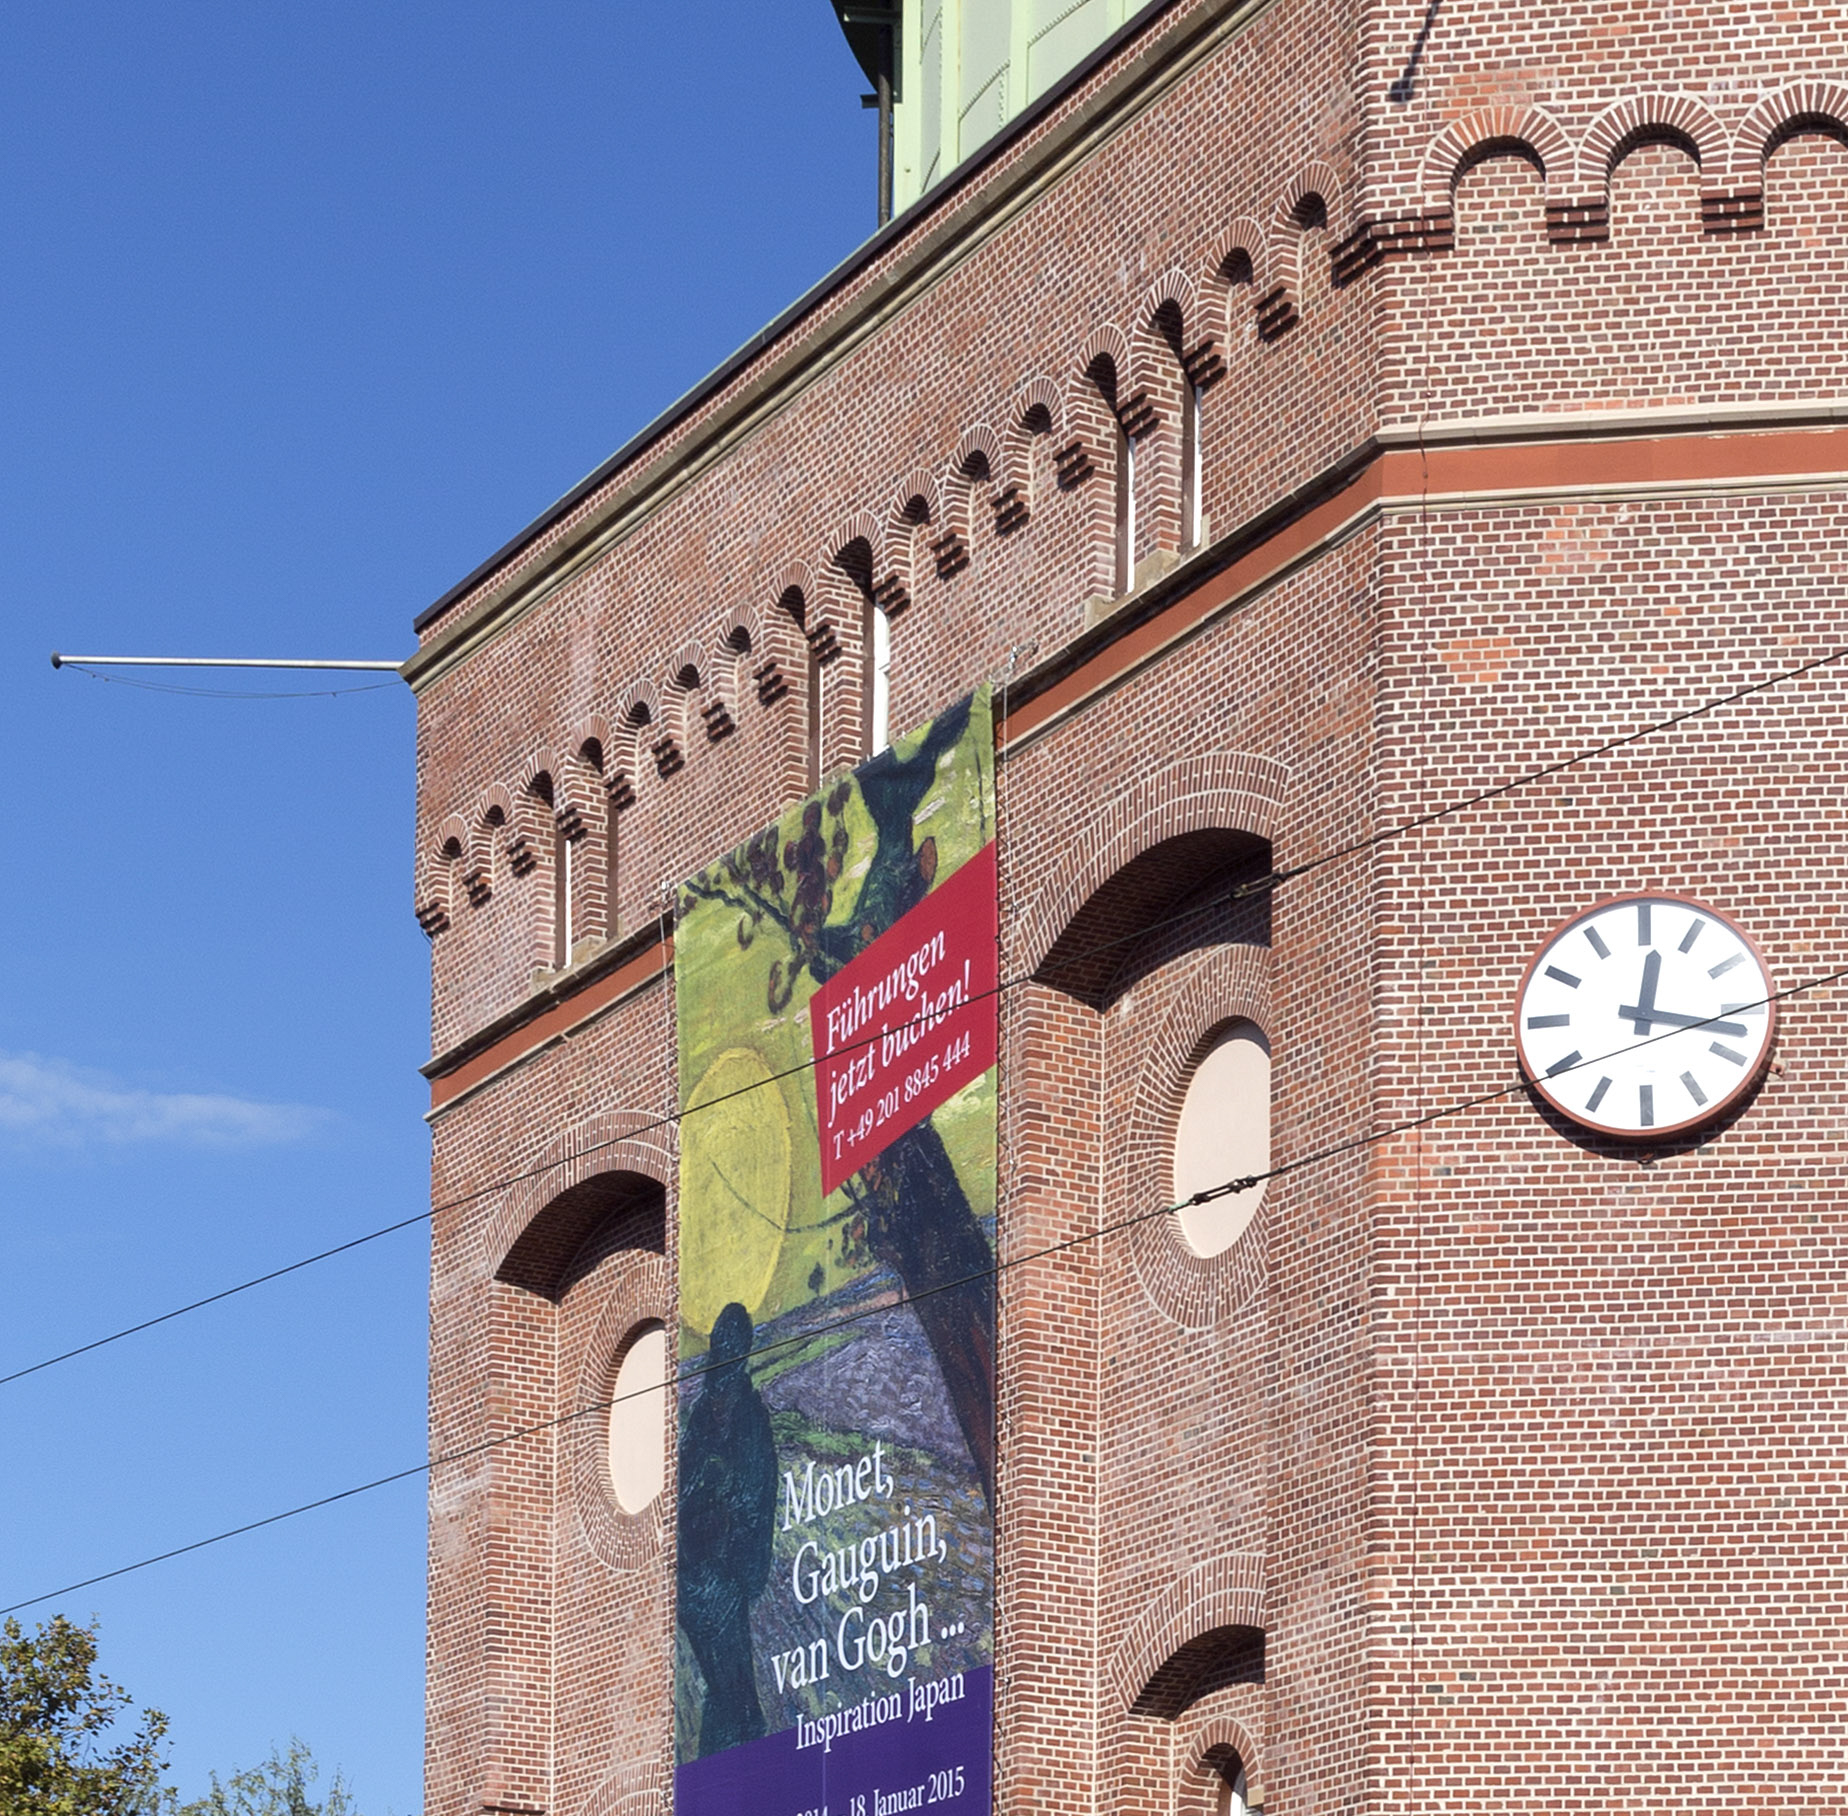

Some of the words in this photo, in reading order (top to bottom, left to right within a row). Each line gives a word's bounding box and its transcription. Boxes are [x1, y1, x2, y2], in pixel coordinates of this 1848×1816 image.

[826, 930, 946, 1055] Führungen
[828, 1042, 876, 1128] jetzt
[881, 959, 971, 1068] buchen!
[833, 1130, 844, 1160] T
[846, 1109, 873, 1147] +49
[876, 1087, 899, 1126] 201
[904, 1054, 939, 1103] 8845
[942, 1031, 970, 1072] 444
[781, 1439, 894, 1533] Monet,
[792, 1505, 947, 1604] Gauguin,
[771, 1637, 830, 1695] van
[837, 1582, 931, 1678] Gogh
[796, 1690, 901, 1753] Inspiration
[907, 1672, 966, 1722] Japan
[927, 1765, 965, 1804] 2015
